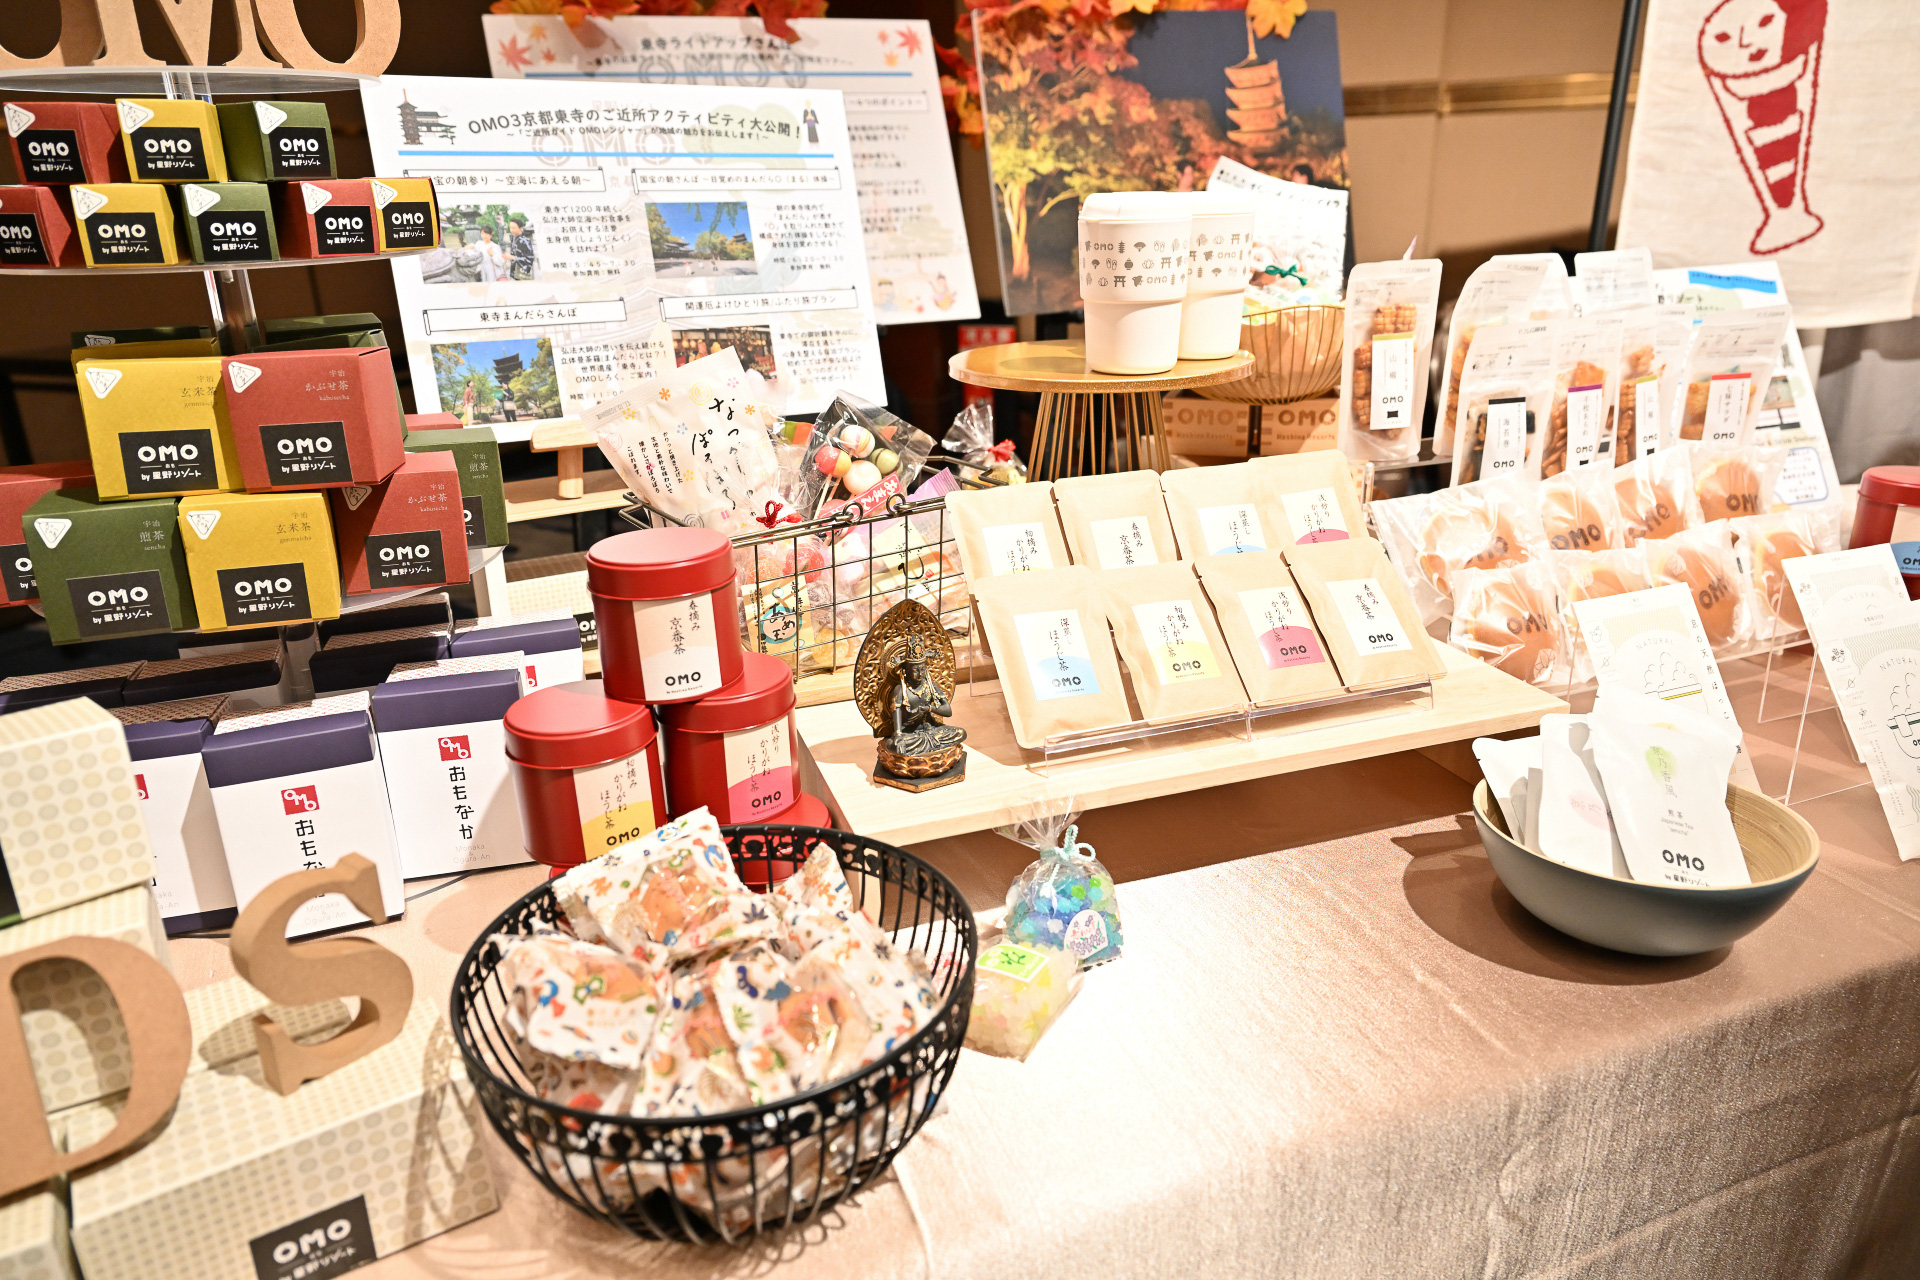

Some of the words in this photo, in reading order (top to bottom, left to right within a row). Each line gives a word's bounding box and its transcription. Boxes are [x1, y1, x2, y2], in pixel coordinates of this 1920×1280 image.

[28, 141, 69, 157] OMO
[144, 139, 192, 153] OMO
[279, 138, 319, 152] OMO
[325, 217, 364, 231] OMO
[391, 212, 424, 226] OMO
[97, 224, 146, 239] OMO
[210, 222, 257, 236] OMO
[1093, 242, 1114, 252] OMO
[329, 369, 345, 378] 宇治
[305, 379, 349, 392] かぶせ茶
[1381, 394, 1405, 405] OMO
[1177, 407, 1235, 426] OMO
[1277, 408, 1337, 427] OMO
[1712, 431, 1736, 441] OMO
[137, 443, 199, 463] OMO
[277, 436, 333, 455] OMO
[1575, 444, 1594, 455] OMO
[281, 466, 290, 474] by
[469, 462, 489, 472] 煎茶
[1493, 459, 1516, 469] OMO
[141, 473, 150, 482] by
[407, 492, 448, 505] かぶせ茶
[142, 519, 161, 529] 宇治
[276, 521, 312, 535] 玄米茶
[139, 530, 165, 543] 煎茶
[279, 535, 312, 544] genmaicha
[1024, 528, 1039, 556] 初摘み
[1550, 524, 1602, 551] OMO
[379, 544, 430, 562] OMO
[1016, 539, 1031, 572] かりがね
[1119, 534, 1135, 566] 京番茶
[381, 570, 390, 578] by
[234, 577, 293, 597] OMO
[87, 586, 149, 607] OMO
[238, 606, 247, 615] by
[688, 599, 701, 632] 春摘み
[92, 616, 102, 625] by
[669, 617, 687, 656] 京番茶
[1166, 614, 1185, 646] かりがね
[1368, 632, 1395, 644] OMO
[1049, 629, 1070, 672] ほうじ茶
[1280, 644, 1308, 657] OMO
[1172, 660, 1202, 673] OMO
[665, 671, 702, 687] OMO
[1051, 675, 1082, 689] OMO
[440, 736, 470, 760] OMO
[759, 738, 772, 778] かりがね
[625, 757, 638, 790] 初摘み
[747, 753, 760, 793] ほうじ茶
[283, 789, 317, 812] OMO
[613, 773, 628, 813] かりがね
[751, 790, 783, 809] OMO
[448, 765, 475, 841] おもなか
[600, 789, 615, 830] ほうじ茶
[606, 826, 641, 847] OMO
[454, 842, 486, 853] Monaka
[1661, 849, 1706, 872] OMO
[272, 1218, 352, 1265] OMO
